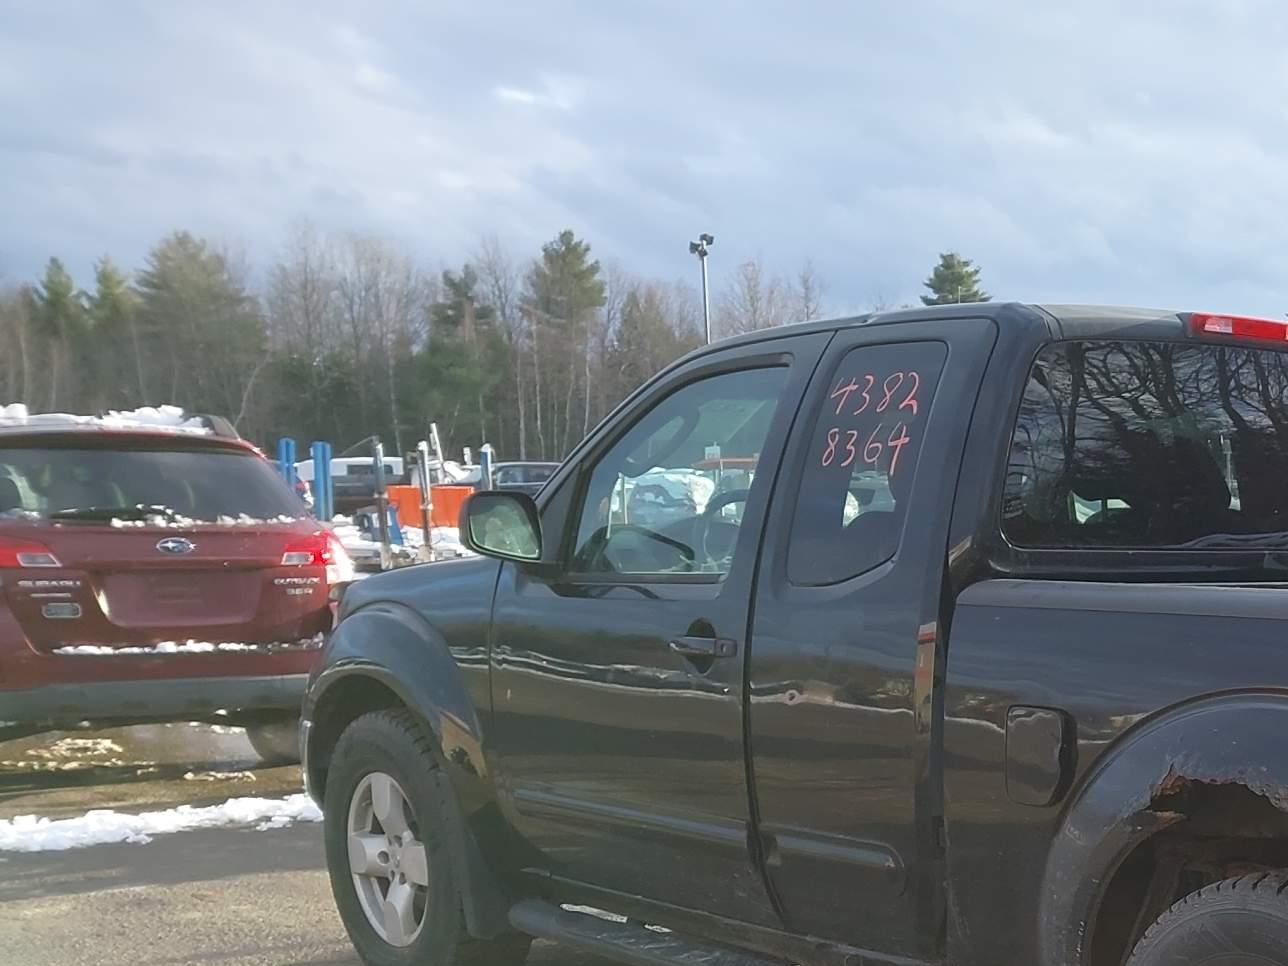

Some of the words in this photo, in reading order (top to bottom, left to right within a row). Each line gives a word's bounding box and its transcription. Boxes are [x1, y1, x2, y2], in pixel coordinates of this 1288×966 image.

[830, 371, 920, 416] 4382
[821, 421, 910, 476] 8364
[17, 580, 80, 588] SUBARU
